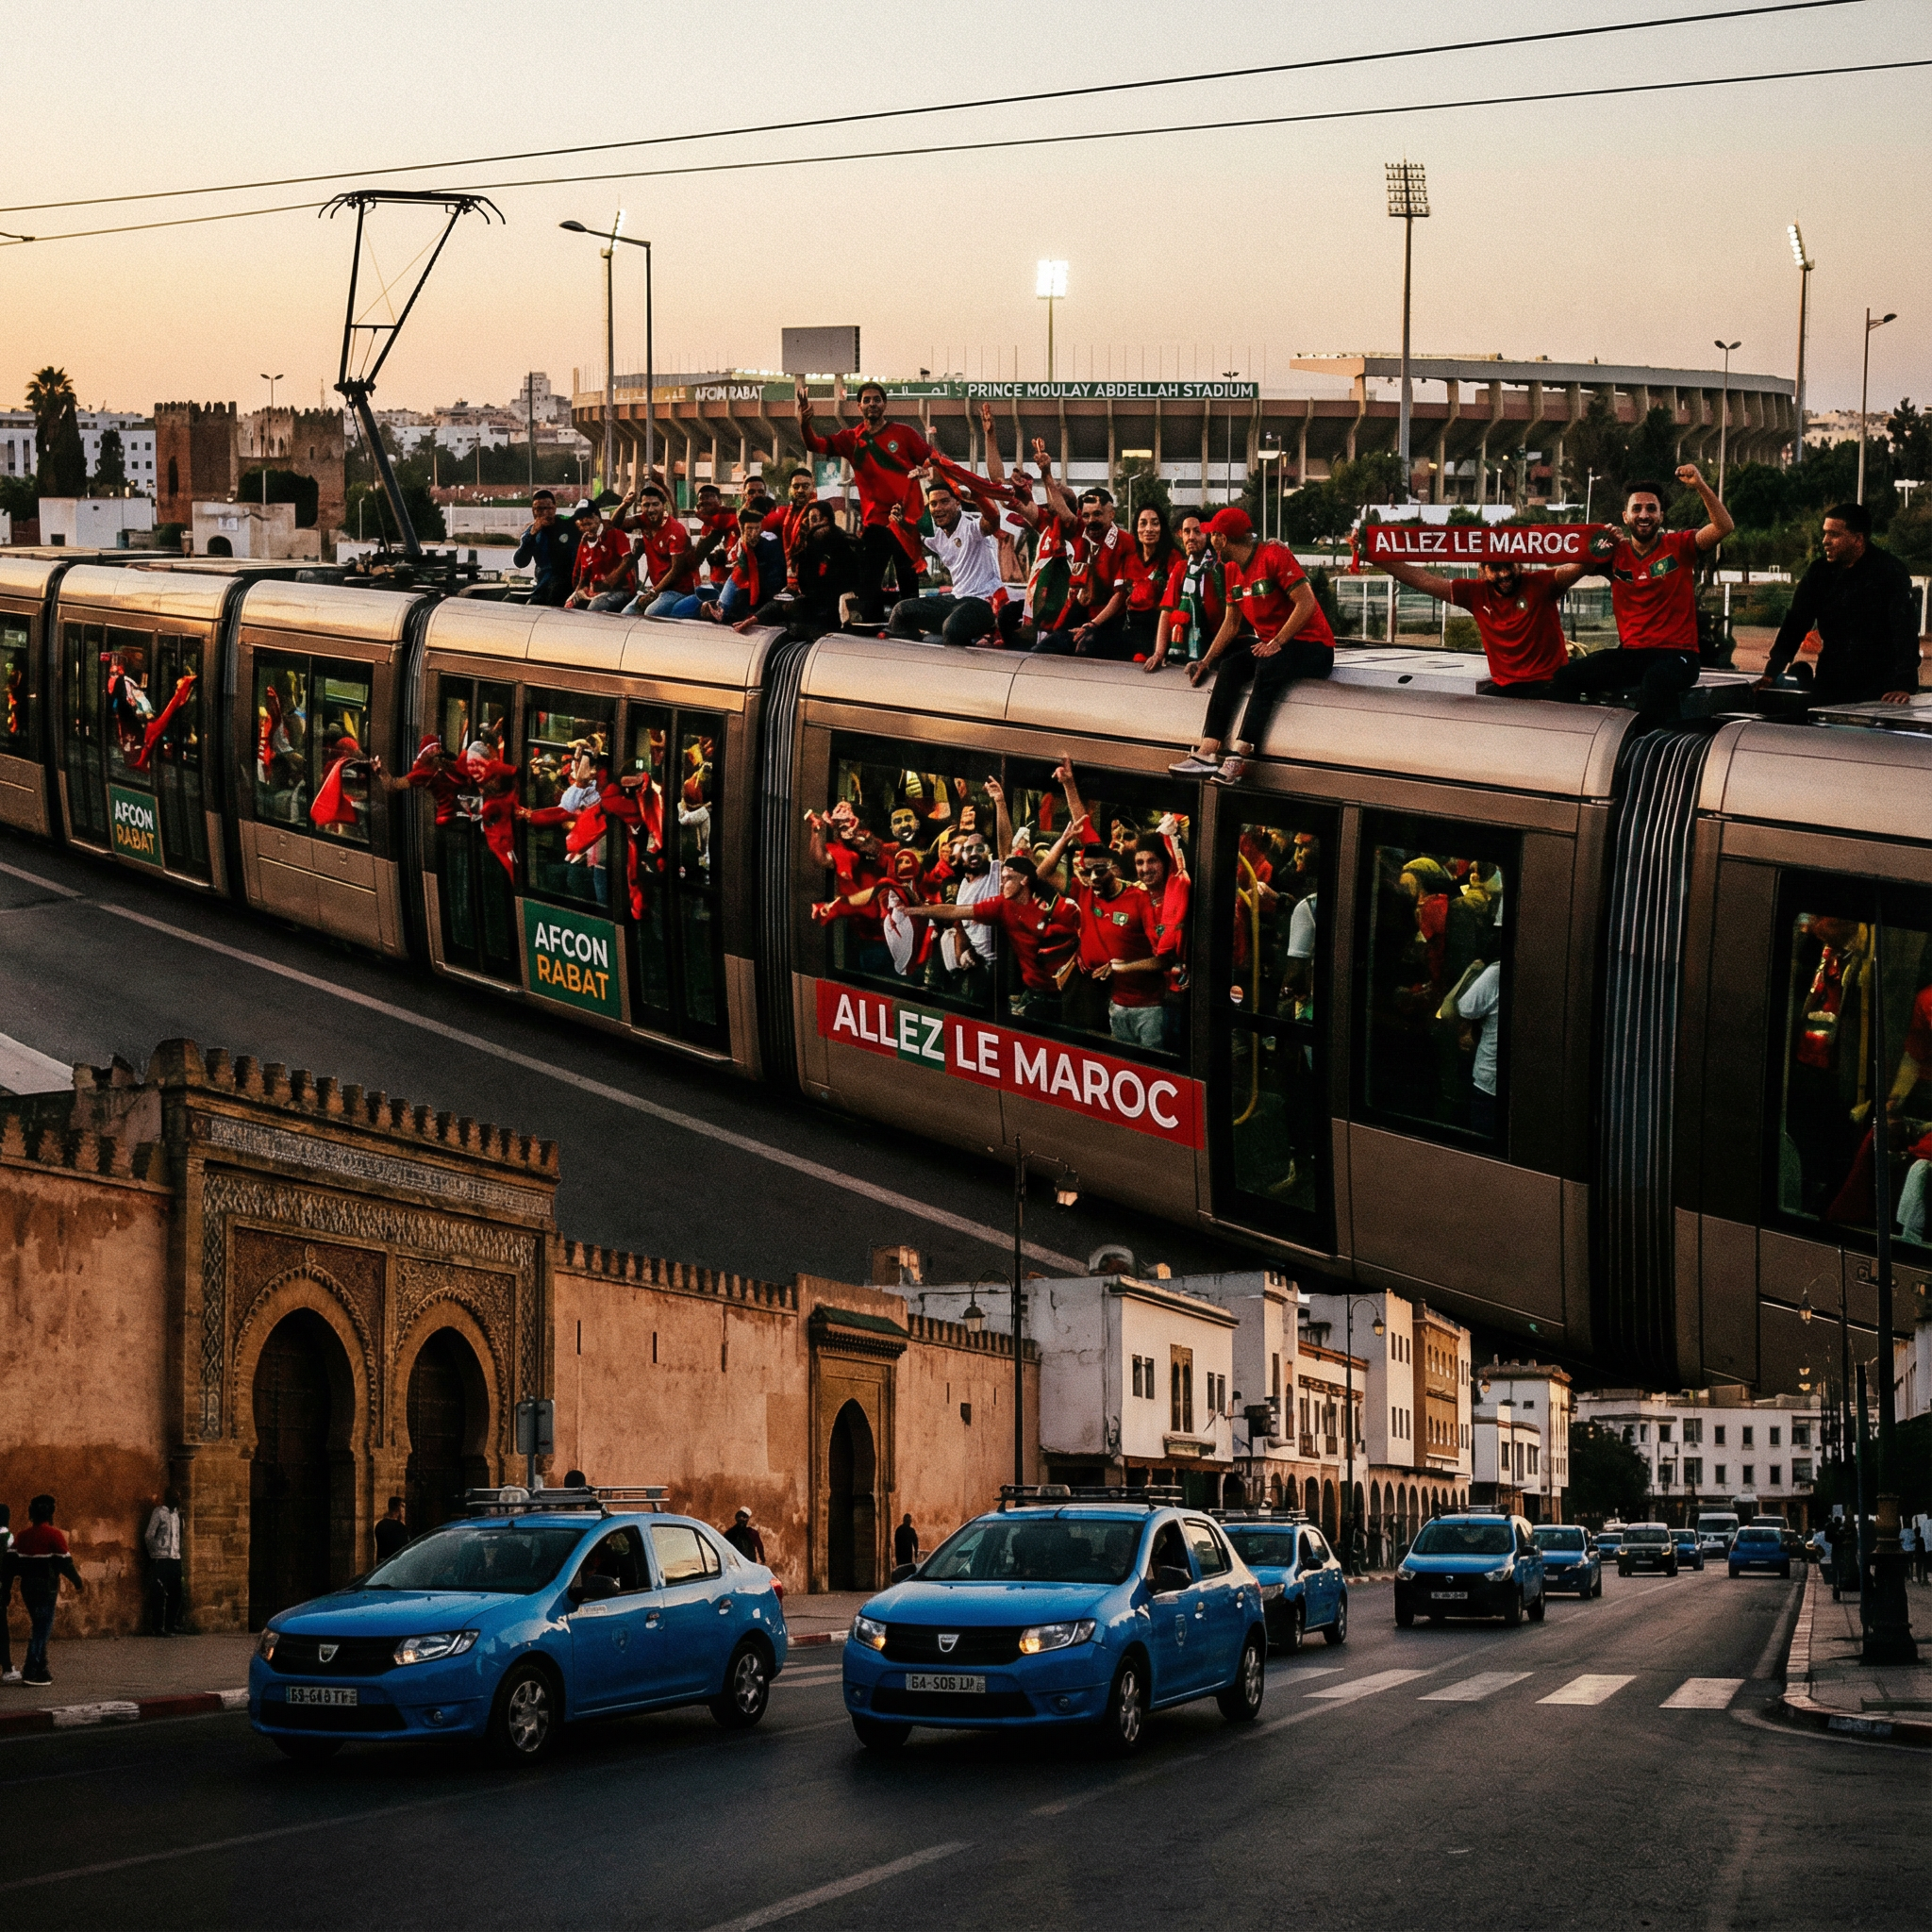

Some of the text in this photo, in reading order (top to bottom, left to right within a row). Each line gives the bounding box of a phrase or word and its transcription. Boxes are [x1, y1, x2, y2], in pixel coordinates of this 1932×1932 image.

[729, 385, 765, 400] RABAT
[968, 383, 1023, 397] PRINCE
[1027, 383, 1089, 397] MOULAY
[1094, 383, 1178, 397] ABDELLAH
[1183, 383, 1253, 397] STADIUM
[1375, 531, 1579, 554] ALLEZ LE MAROC
[115, 799, 154, 830] AFCON
[116, 824, 154, 855] RABAT
[535, 922, 608, 968] AFCON
[537, 954, 609, 1000] RABAT
[833, 993, 1179, 1128] ALLEZ LE MAROC
